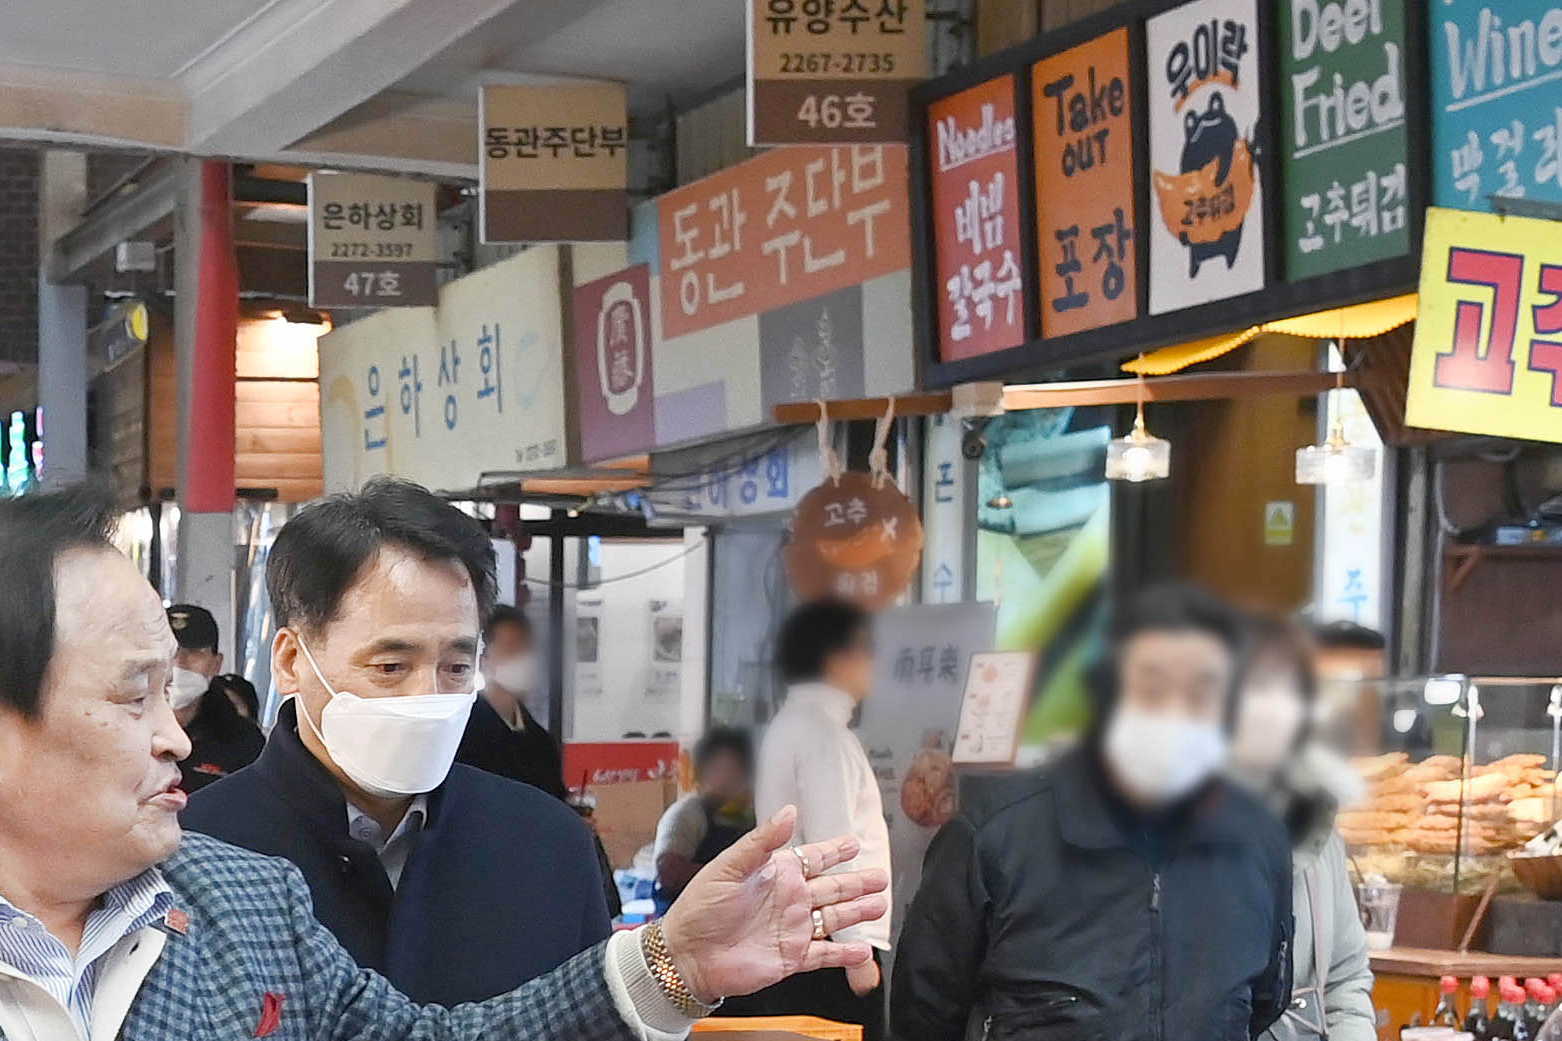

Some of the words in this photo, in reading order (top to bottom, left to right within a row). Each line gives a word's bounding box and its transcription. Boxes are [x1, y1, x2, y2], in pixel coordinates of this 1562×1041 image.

[779, 53, 895, 73] 2267-2735
[1444, 8, 1562, 99] Wine
[798, 92, 876, 128] 46호
[1043, 66, 1124, 136] Take
[1291, 42, 1406, 146] Fried
[485, 126, 625, 159] 동관주단부
[937, 103, 1016, 170] Noodles
[323, 202, 423, 231] 은하상회
[955, 171, 1005, 255] 비빔
[1298, 163, 1406, 253] 고추튀김
[343, 271, 403, 297] 47호
[946, 249, 1022, 341] 칼국수
[1053, 208, 1133, 312] 포장
[364, 322, 504, 452] 은하상회
[823, 498, 868, 527] 고추
